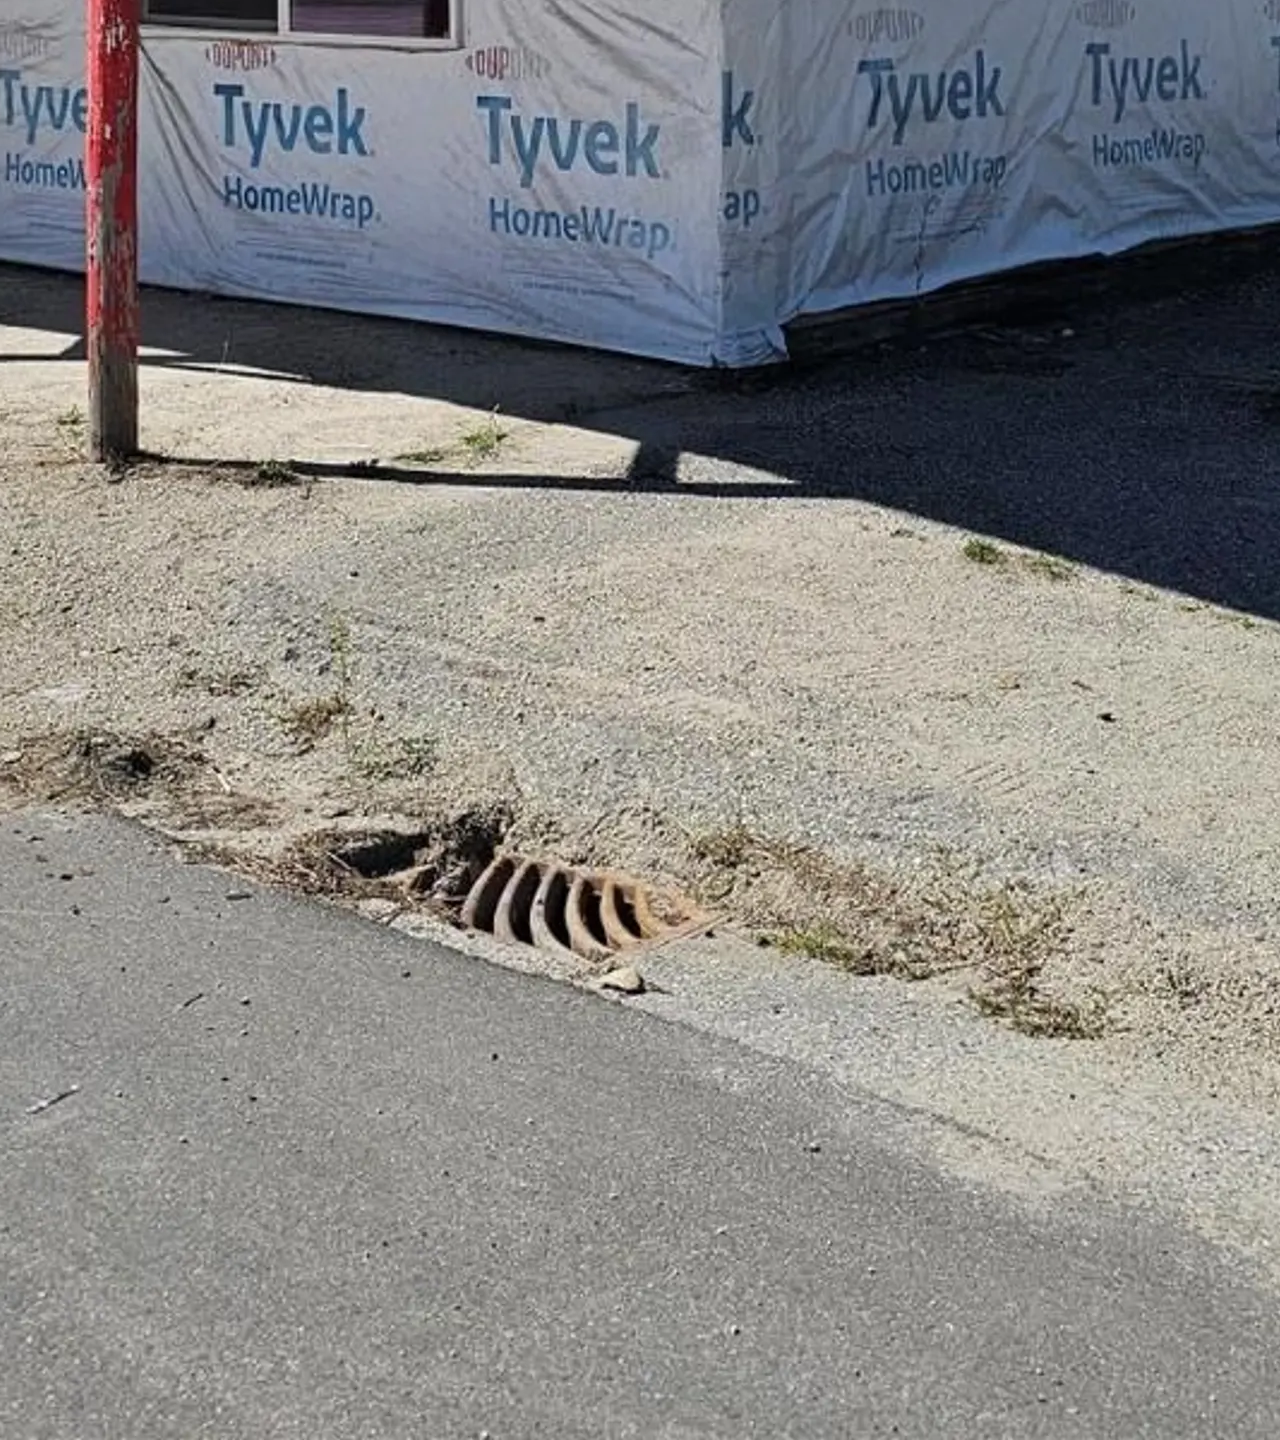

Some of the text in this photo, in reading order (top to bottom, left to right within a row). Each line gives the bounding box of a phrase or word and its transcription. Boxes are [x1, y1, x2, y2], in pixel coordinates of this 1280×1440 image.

[856, 48, 1005, 146] Tyvek
[1085, 38, 1203, 124] Tyvek
[214, 84, 368, 168] Tyvek
[477, 96, 661, 189] Tyvek
[1093, 127, 1205, 168] HomeWrap
[224, 175, 375, 228] HomeWrap
[866, 150, 1007, 197] HomeWrap
[490, 197, 670, 259] HomeWrap
